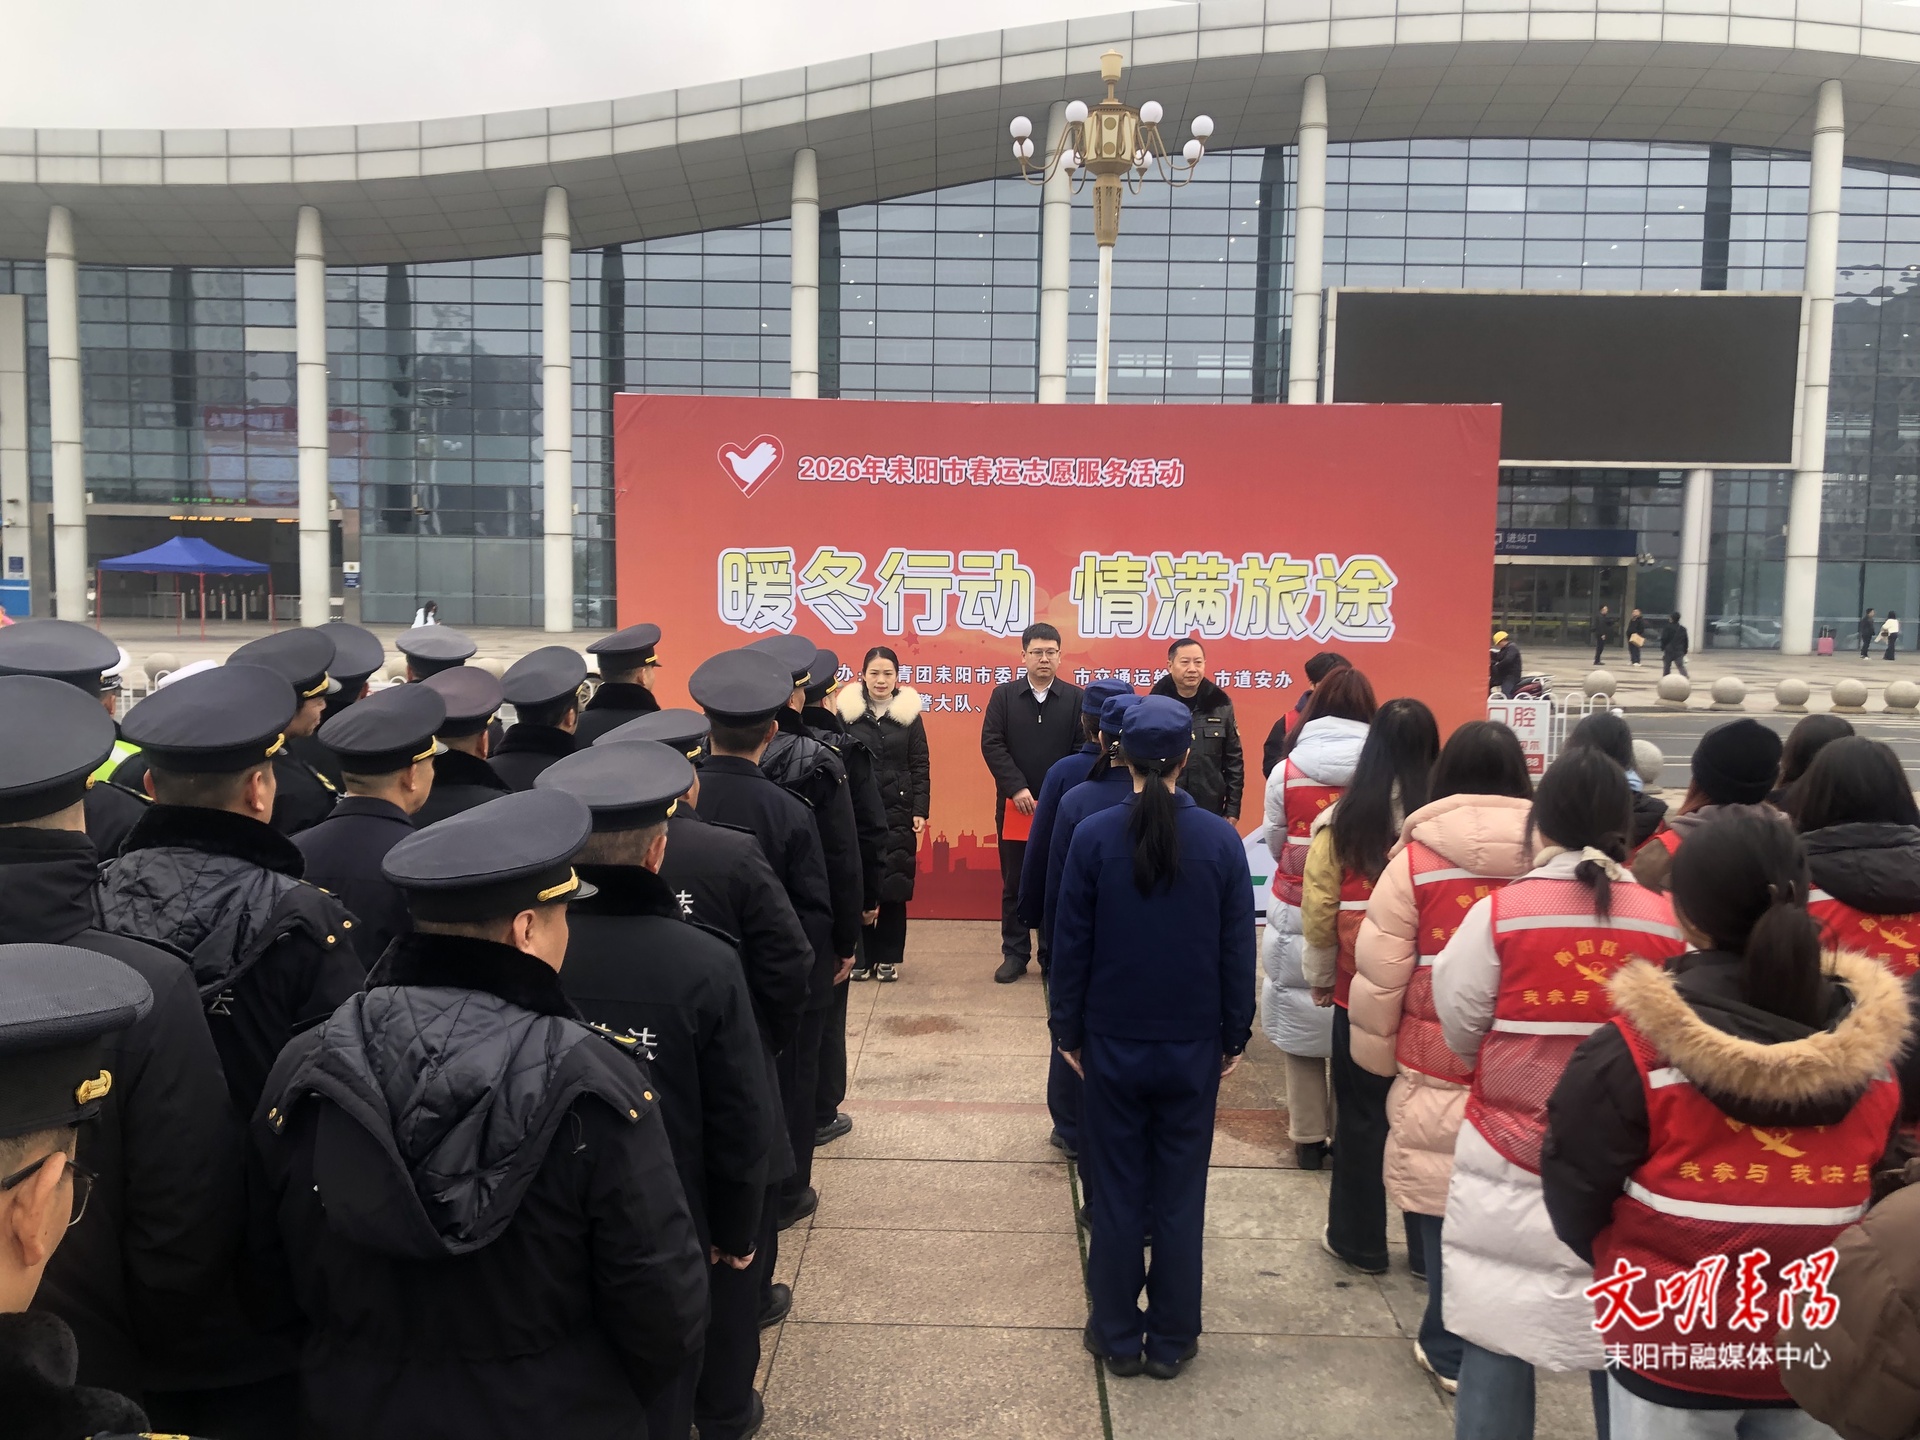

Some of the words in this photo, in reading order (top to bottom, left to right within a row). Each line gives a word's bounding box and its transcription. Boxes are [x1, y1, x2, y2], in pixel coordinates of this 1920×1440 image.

[798, 455, 1185, 488] 2026年耒阳市春运志愿服务活动
[1506, 532, 1537, 543] 进站口
[718, 546, 1035, 636] 暖冬行动
[1069, 551, 1398, 643] 情满旅途
[1214, 669, 1293, 689] 市道安办
[1679, 1161, 1769, 1184] 我参与
